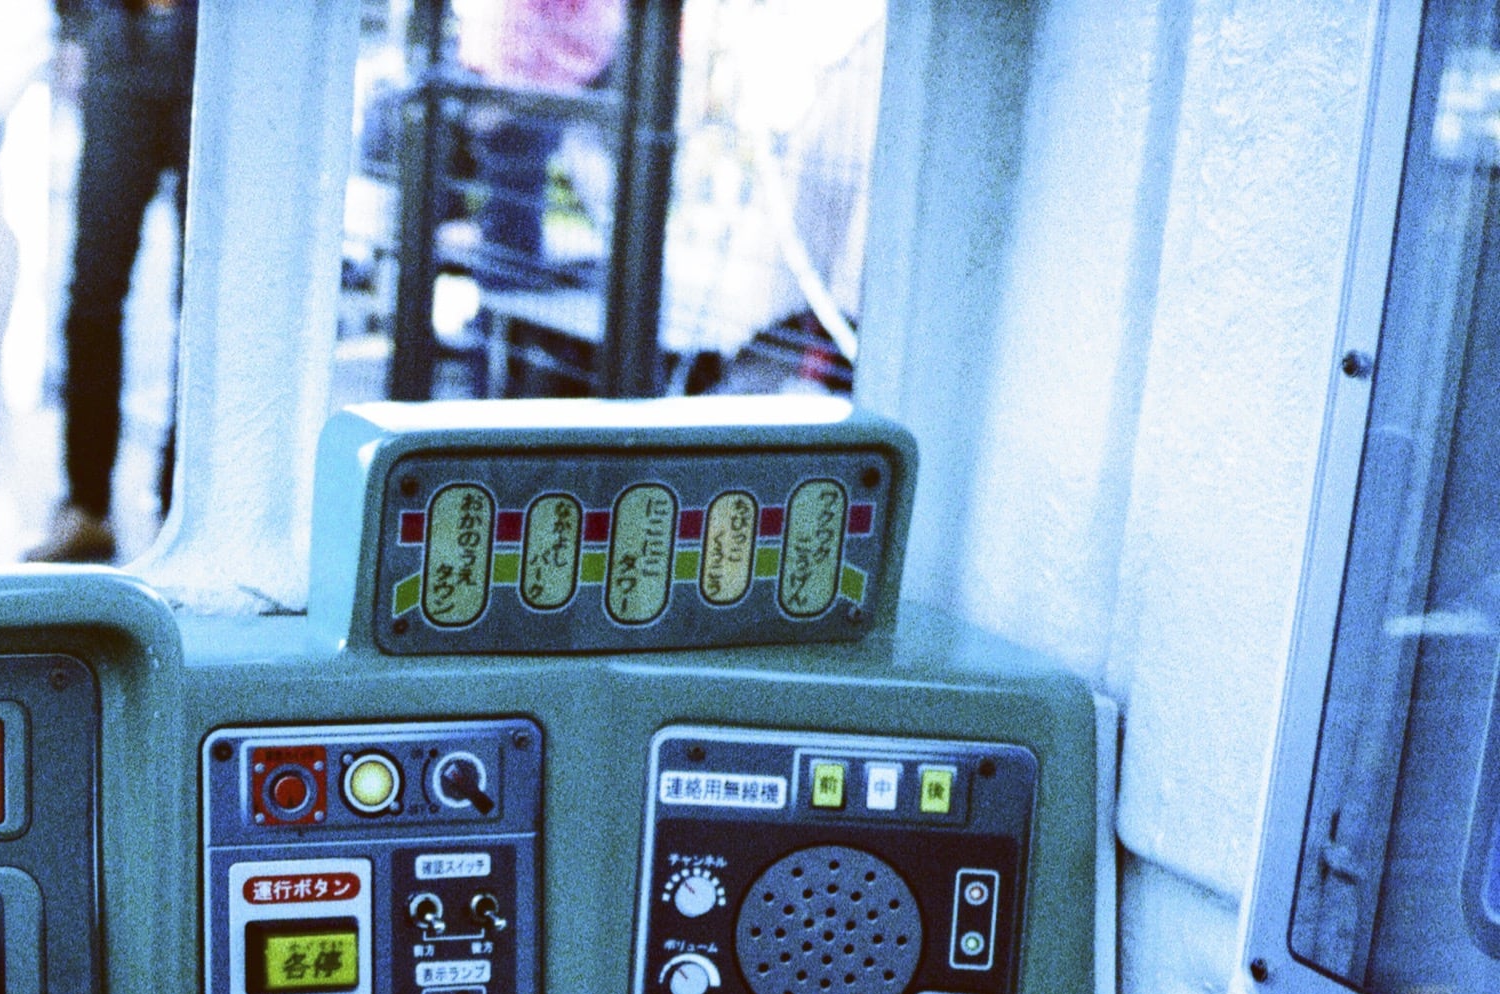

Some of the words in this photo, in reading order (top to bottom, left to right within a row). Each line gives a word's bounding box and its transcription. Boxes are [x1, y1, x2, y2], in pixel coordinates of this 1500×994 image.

[456, 493, 483, 586] おかのうえ
[552, 501, 572, 568] なかよし
[642, 498, 667, 577] にこにこ
[812, 489, 838, 565] ワクワク
[432, 563, 455, 615] タウン
[530, 551, 550, 599] パーク
[616, 555, 637, 615] タワー
[666, 776, 780, 804] 連絡用無線機
[874, 779, 892, 798] 中
[421, 861, 485, 876] 確認スイッチ
[668, 853, 728, 868] チャンネル
[253, 878, 351, 901] 運行ボタン
[283, 952, 344, 980] 各停
[423, 965, 486, 983] 表示ランプ
